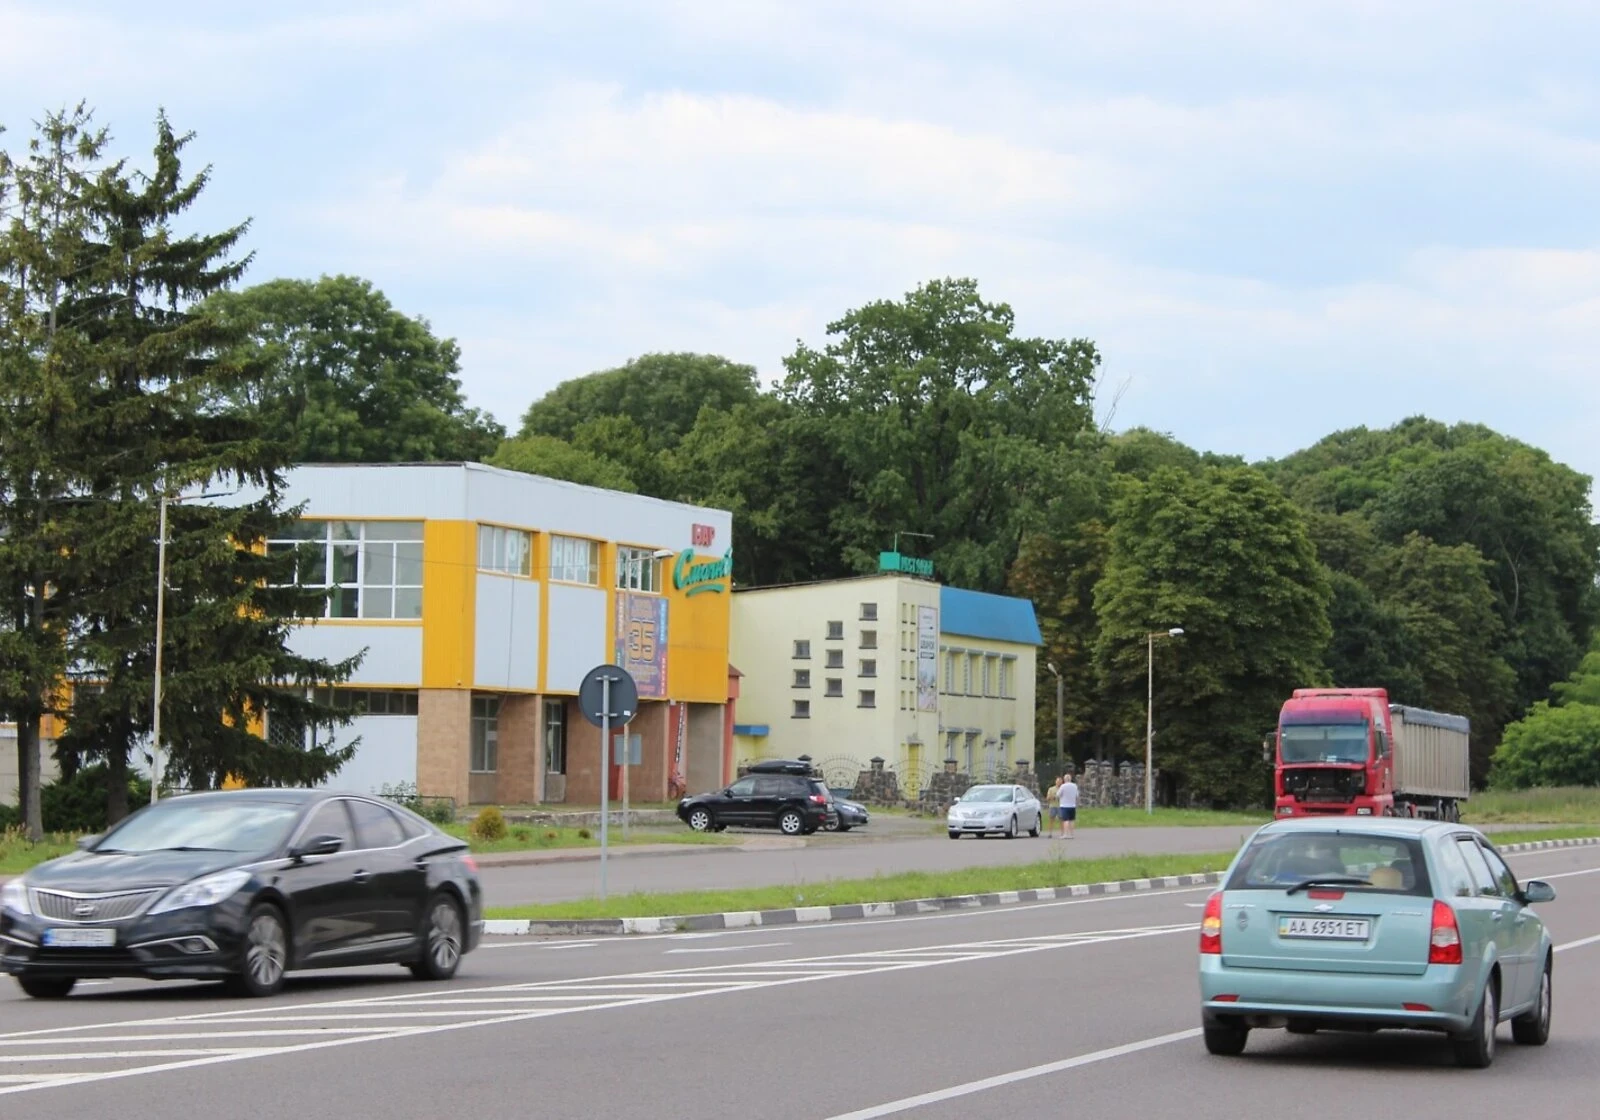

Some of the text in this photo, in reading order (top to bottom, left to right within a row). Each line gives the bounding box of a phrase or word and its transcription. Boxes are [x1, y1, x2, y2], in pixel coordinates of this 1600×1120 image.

[692, 524, 715, 548] БАР
[629, 618, 655, 662] 35
[1289, 920, 1365, 936] AA 6951 ET
